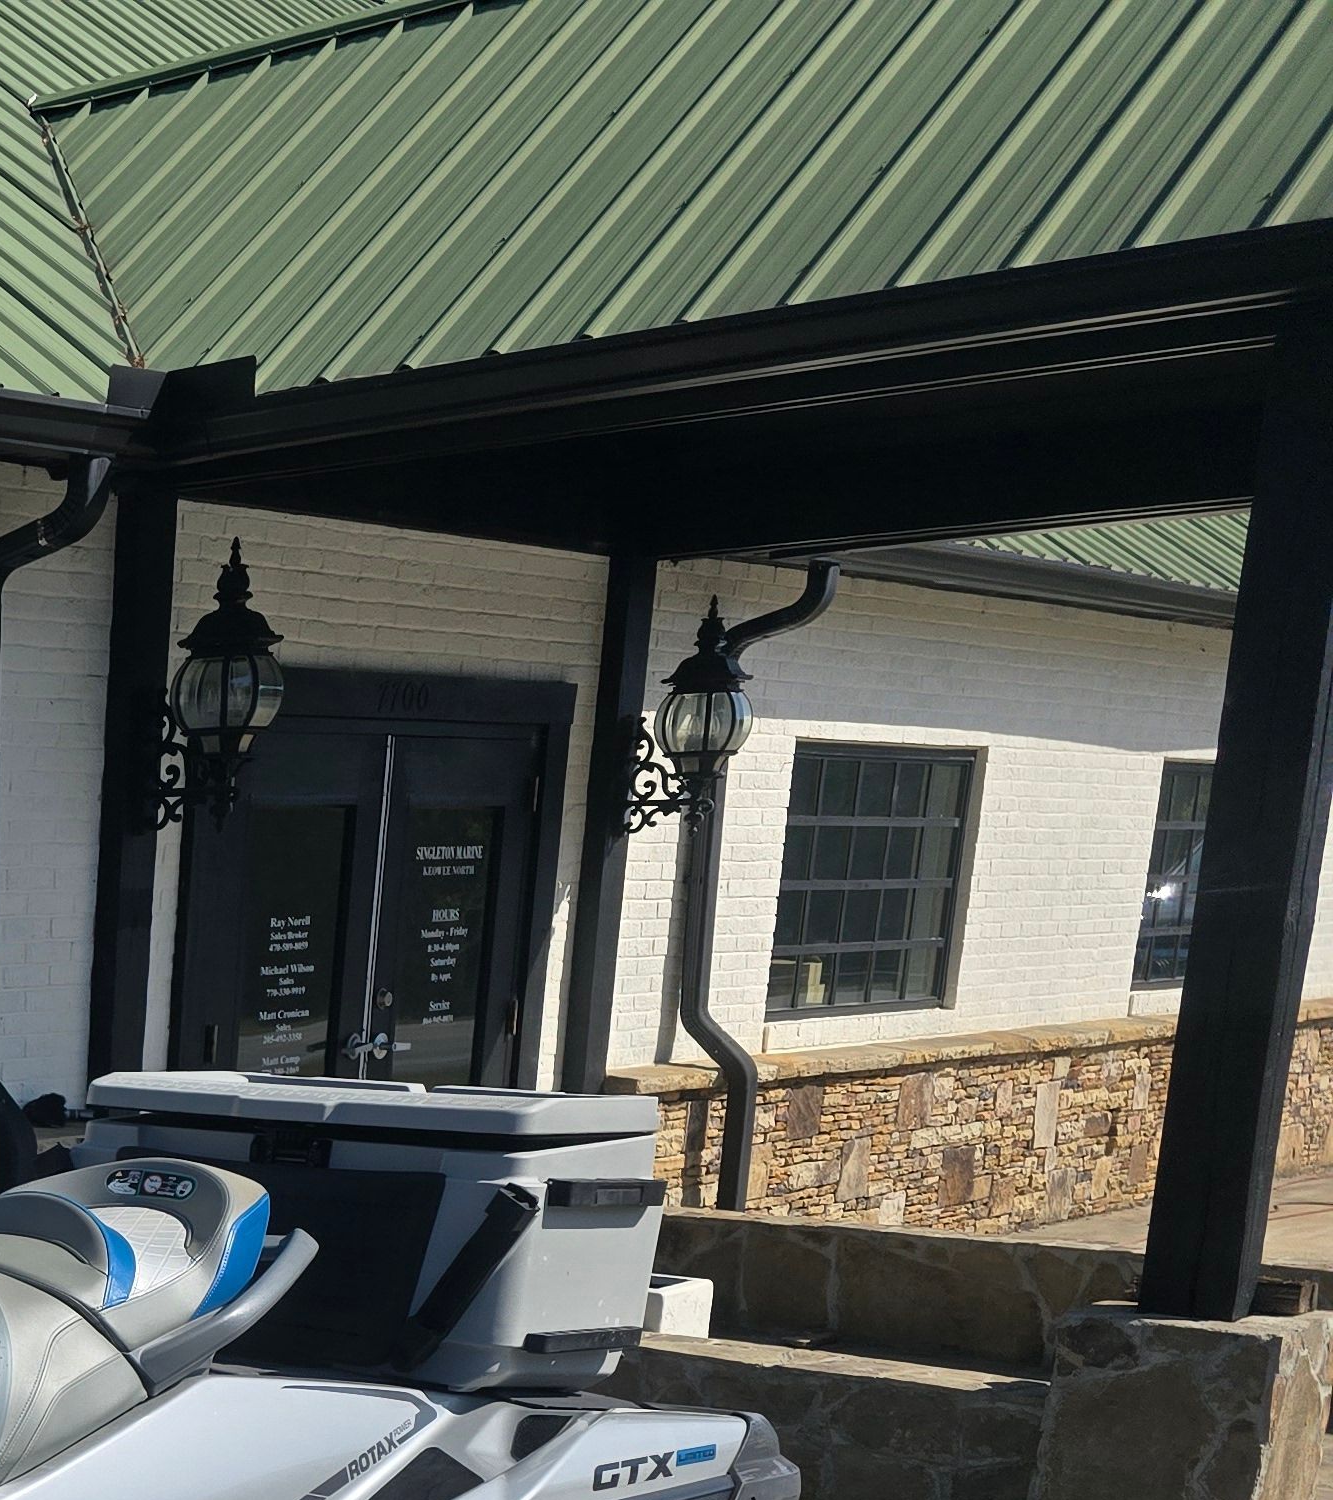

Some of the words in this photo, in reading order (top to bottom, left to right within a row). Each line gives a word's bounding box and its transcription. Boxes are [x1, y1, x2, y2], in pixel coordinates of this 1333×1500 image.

[416, 846, 455, 860] SINGLETON
[456, 845, 483, 859] MARINE
[423, 866, 451, 876] KEOWEE
[453, 865, 475, 875] NORTH
[432, 908, 460, 922] HOURS
[270, 917, 285, 930] Ray
[270, 932, 286, 940] Sales
[420, 929, 445, 940] Monday
[450, 926, 468, 938] Friday
[430, 956, 457, 967] Saturday
[260, 965, 289, 976] Michael
[290, 964, 315, 973] Wilson
[429, 1000, 450, 1011] Service
[259, 1011, 277, 1021] Matt
[348, 1432, 398, 1481] ROTAX
[393, 1418, 413, 1438] POWER
[593, 1451, 675, 1491] GTX
